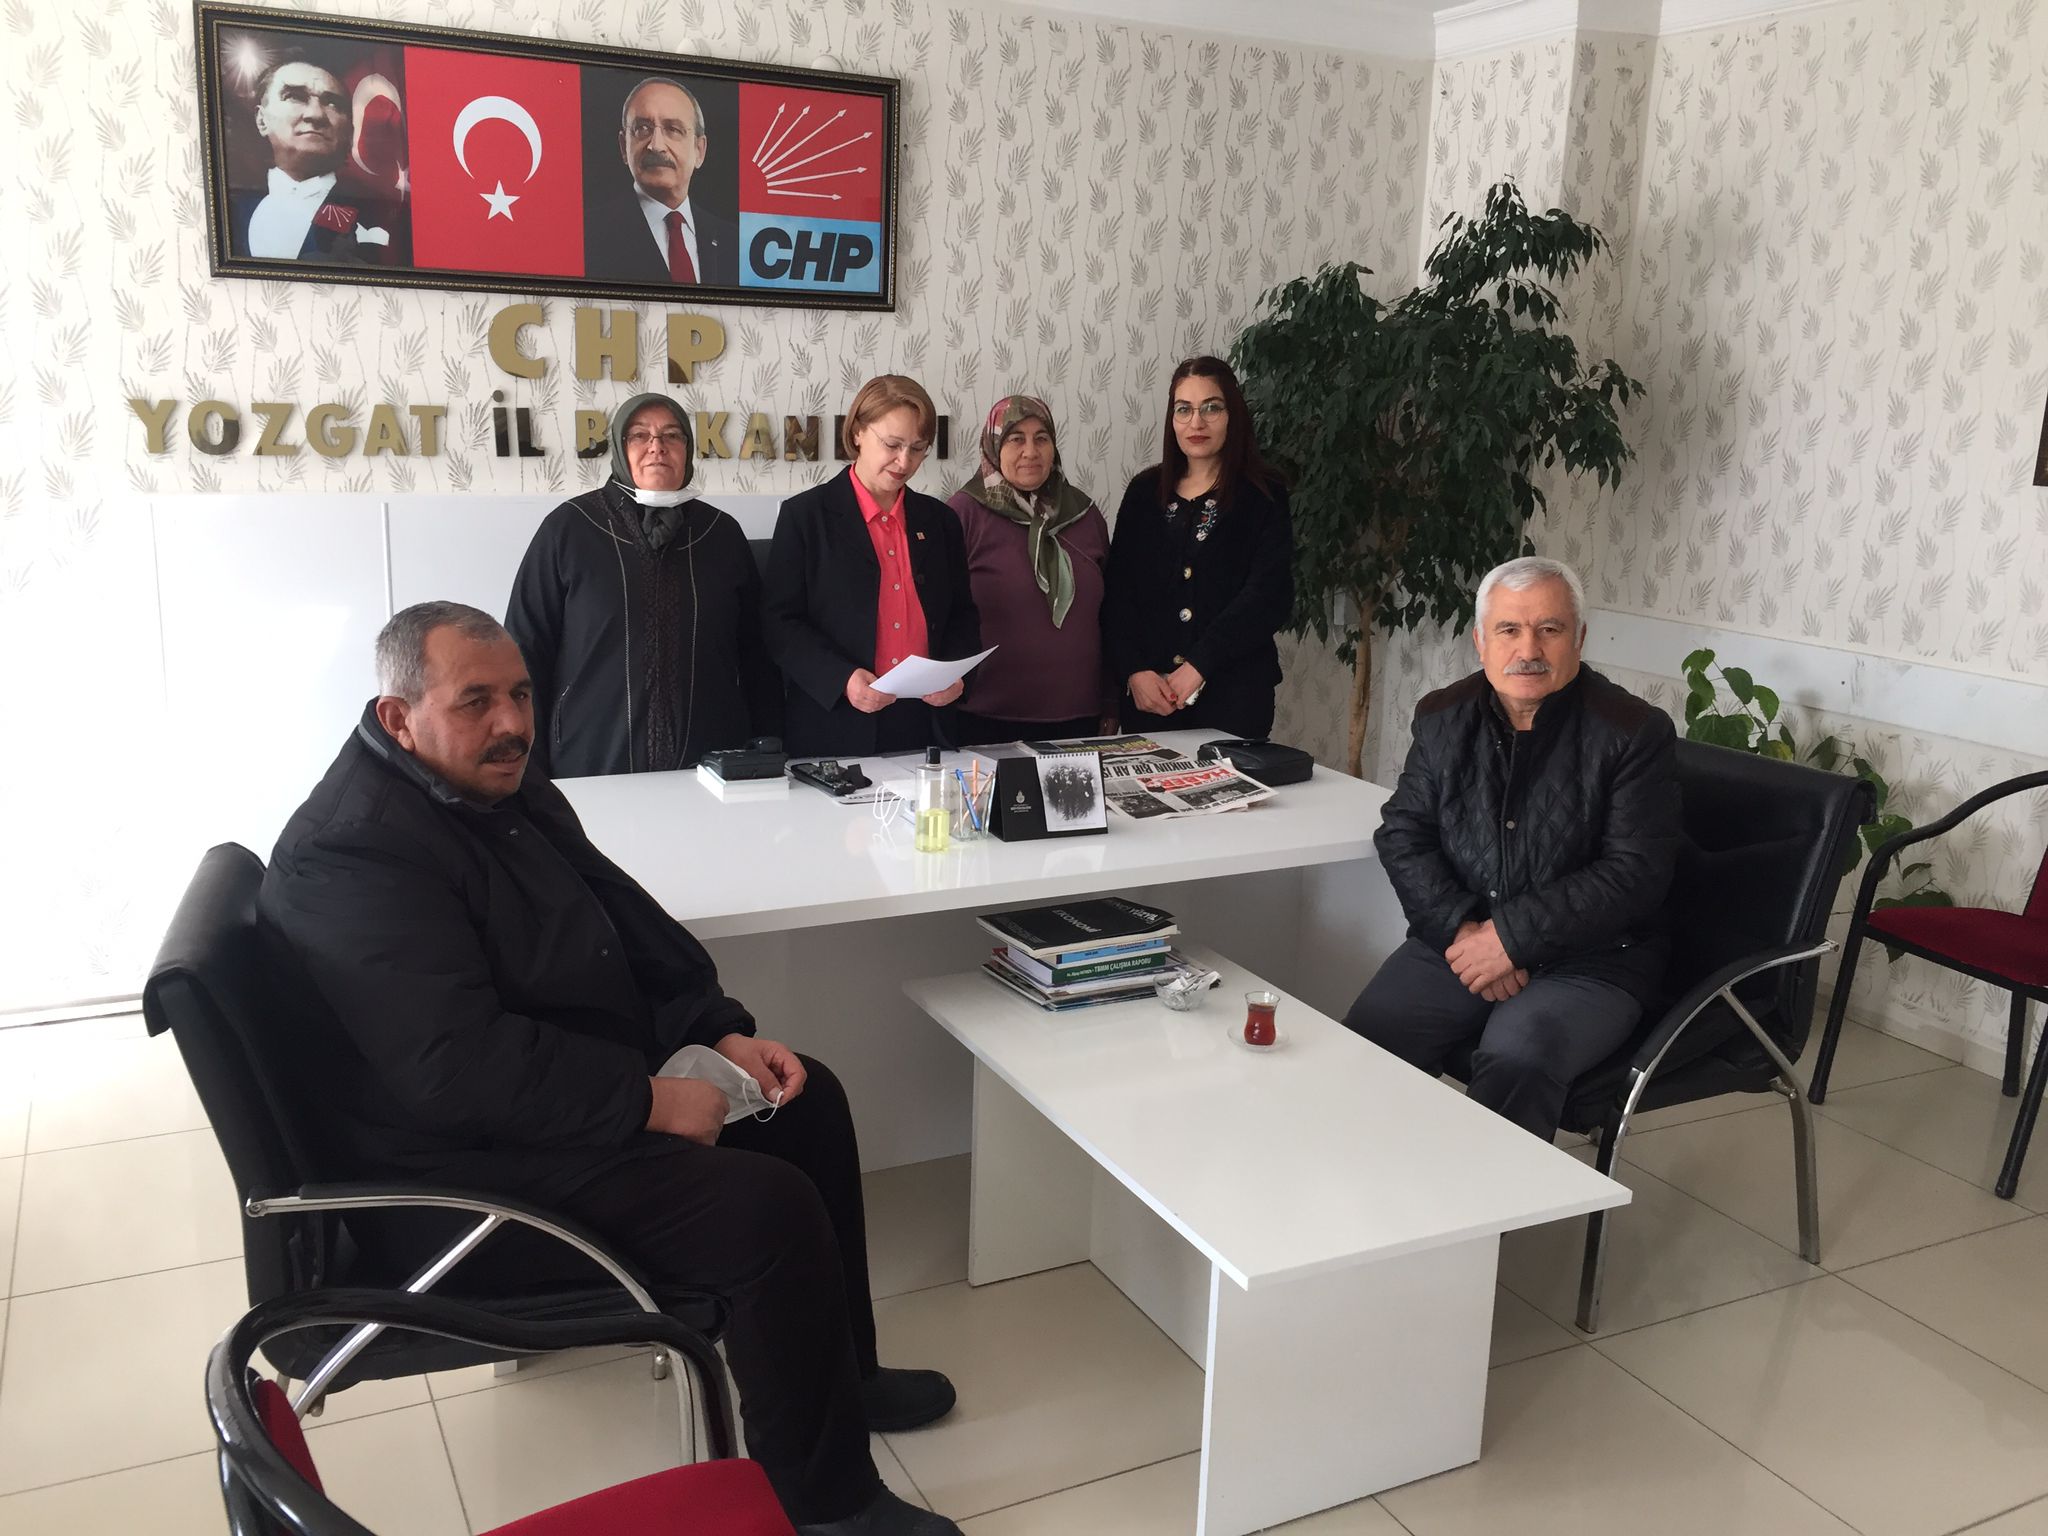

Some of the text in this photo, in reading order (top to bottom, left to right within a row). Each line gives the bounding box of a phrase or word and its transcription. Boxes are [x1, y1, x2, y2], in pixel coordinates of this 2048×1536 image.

[749, 227, 874, 283] CHP
[488, 303, 725, 384] CHP
[127, 399, 446, 457] YOZGAT
[493, 390, 546, 457] İL
[1112, 765, 1131, 777] AH
[1132, 763, 1153, 775] BİR
[1161, 769, 1231, 788] HABER
[1110, 960, 1132, 971] ÇALIŞMA
[1131, 957, 1152, 967] RAPORU
